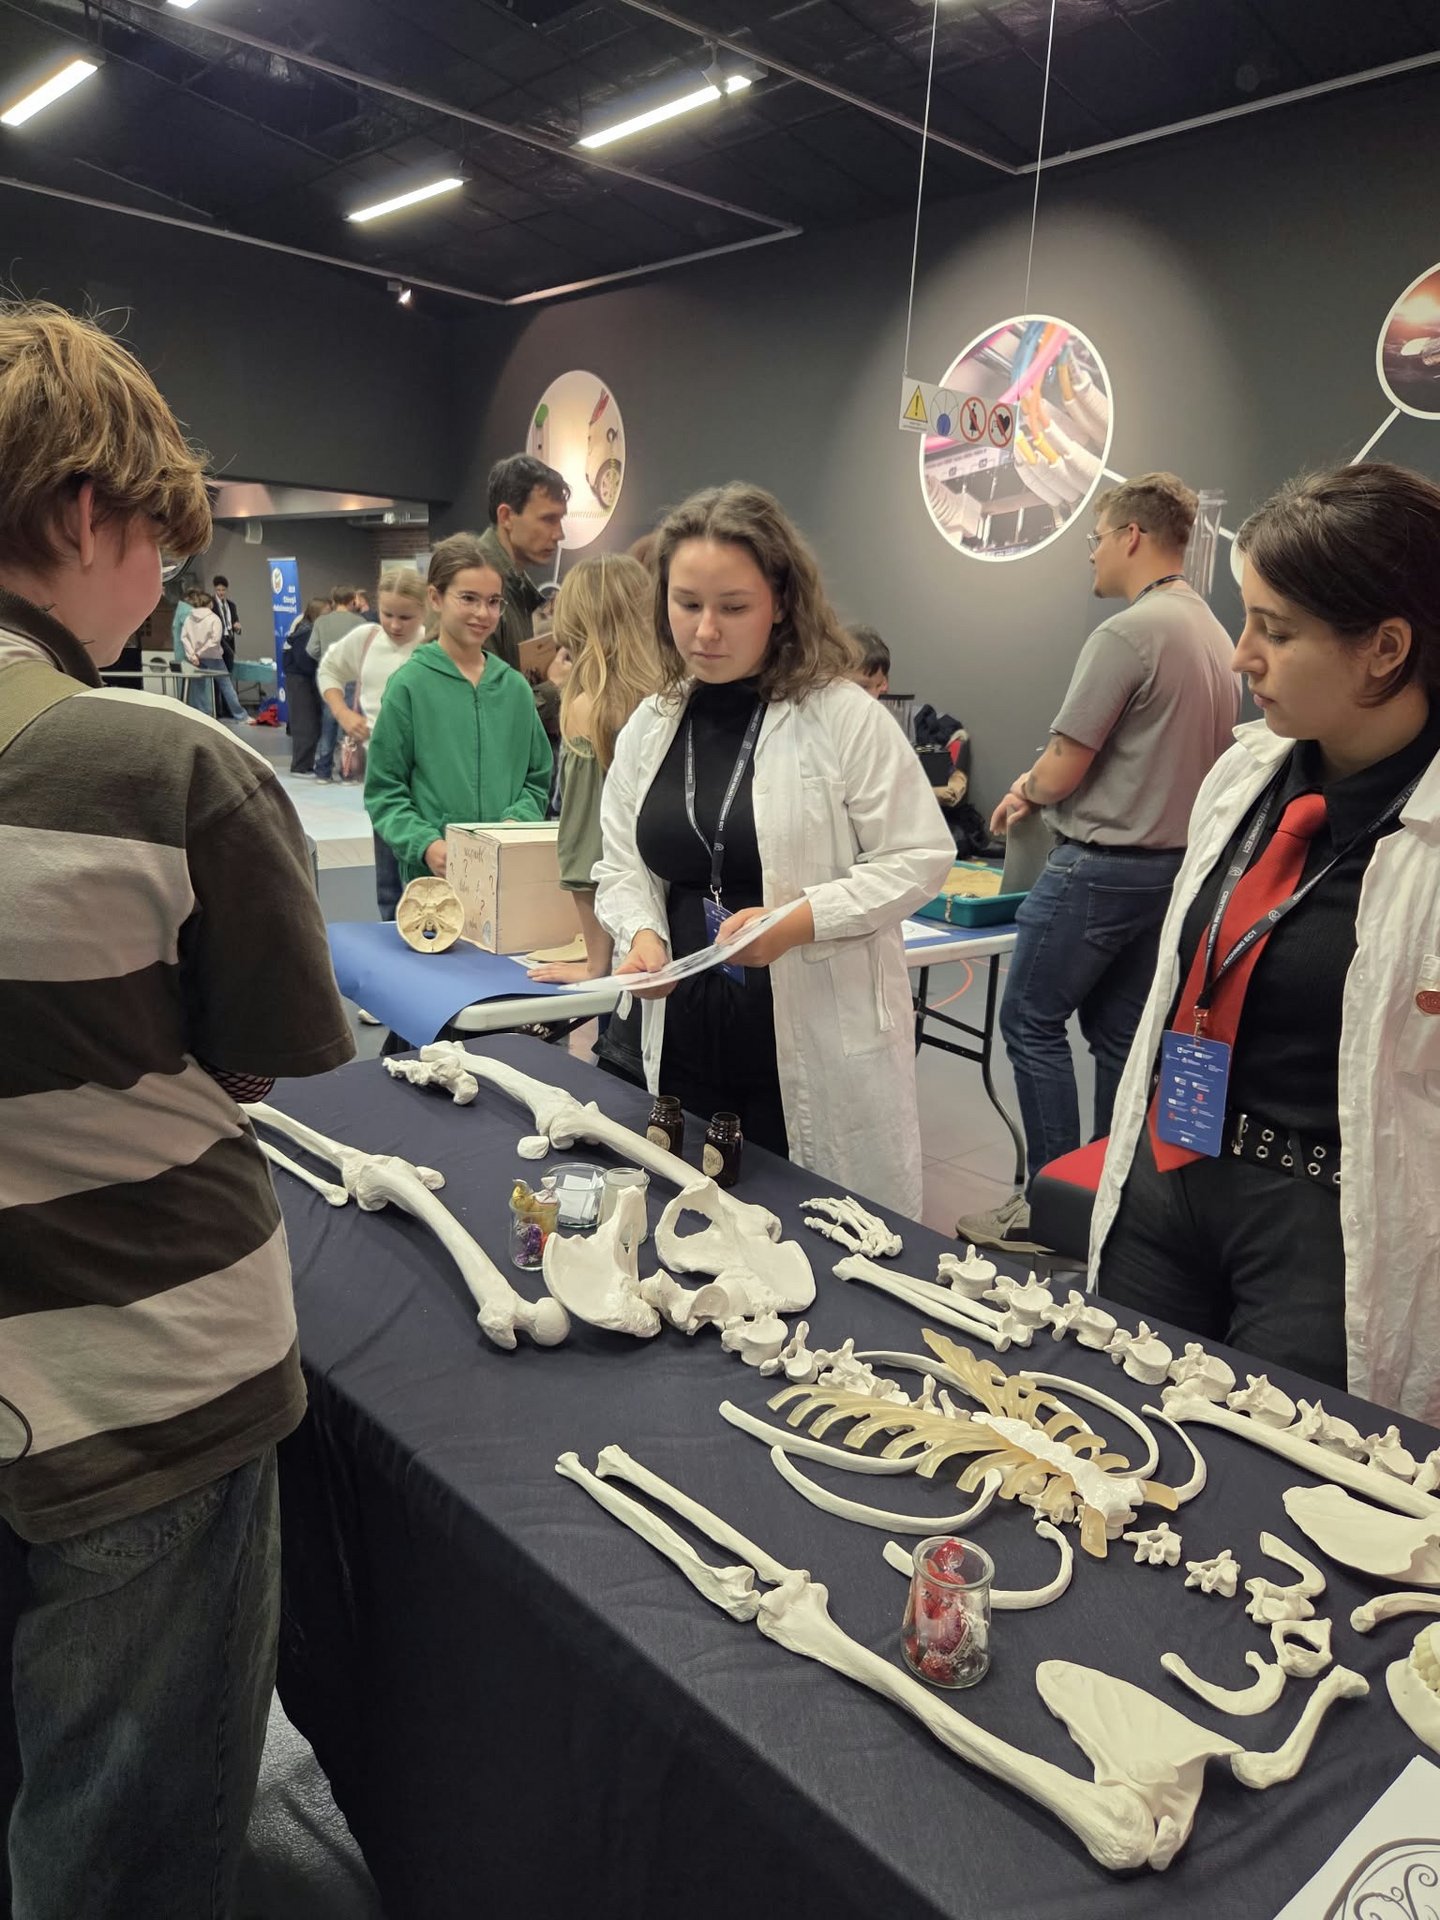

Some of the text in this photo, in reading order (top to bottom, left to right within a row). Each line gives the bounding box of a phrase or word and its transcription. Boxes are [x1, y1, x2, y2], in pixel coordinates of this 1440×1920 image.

[1249, 812, 1267, 840] TECHNIKI
[1242, 840, 1253, 853] EC1
[1214, 890, 1229, 923] CENTRUM
[1243, 929, 1257, 942] EC1
